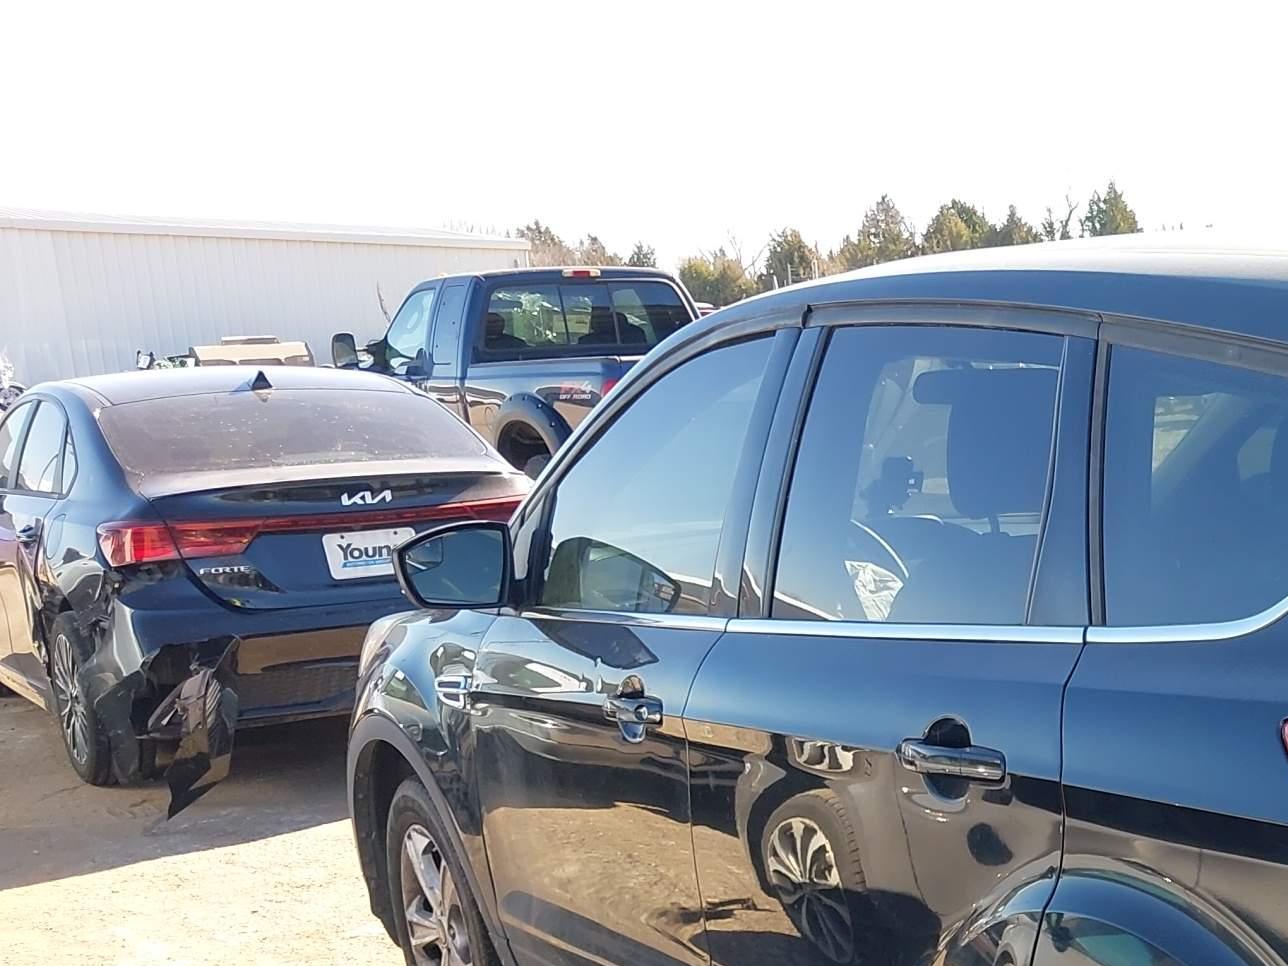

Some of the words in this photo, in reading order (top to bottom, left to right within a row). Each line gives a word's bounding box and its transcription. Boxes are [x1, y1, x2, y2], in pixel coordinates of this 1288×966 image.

[340, 489, 393, 506] KIA
[336, 542, 393, 561] Youn
[199, 565, 252, 575] FORTE
